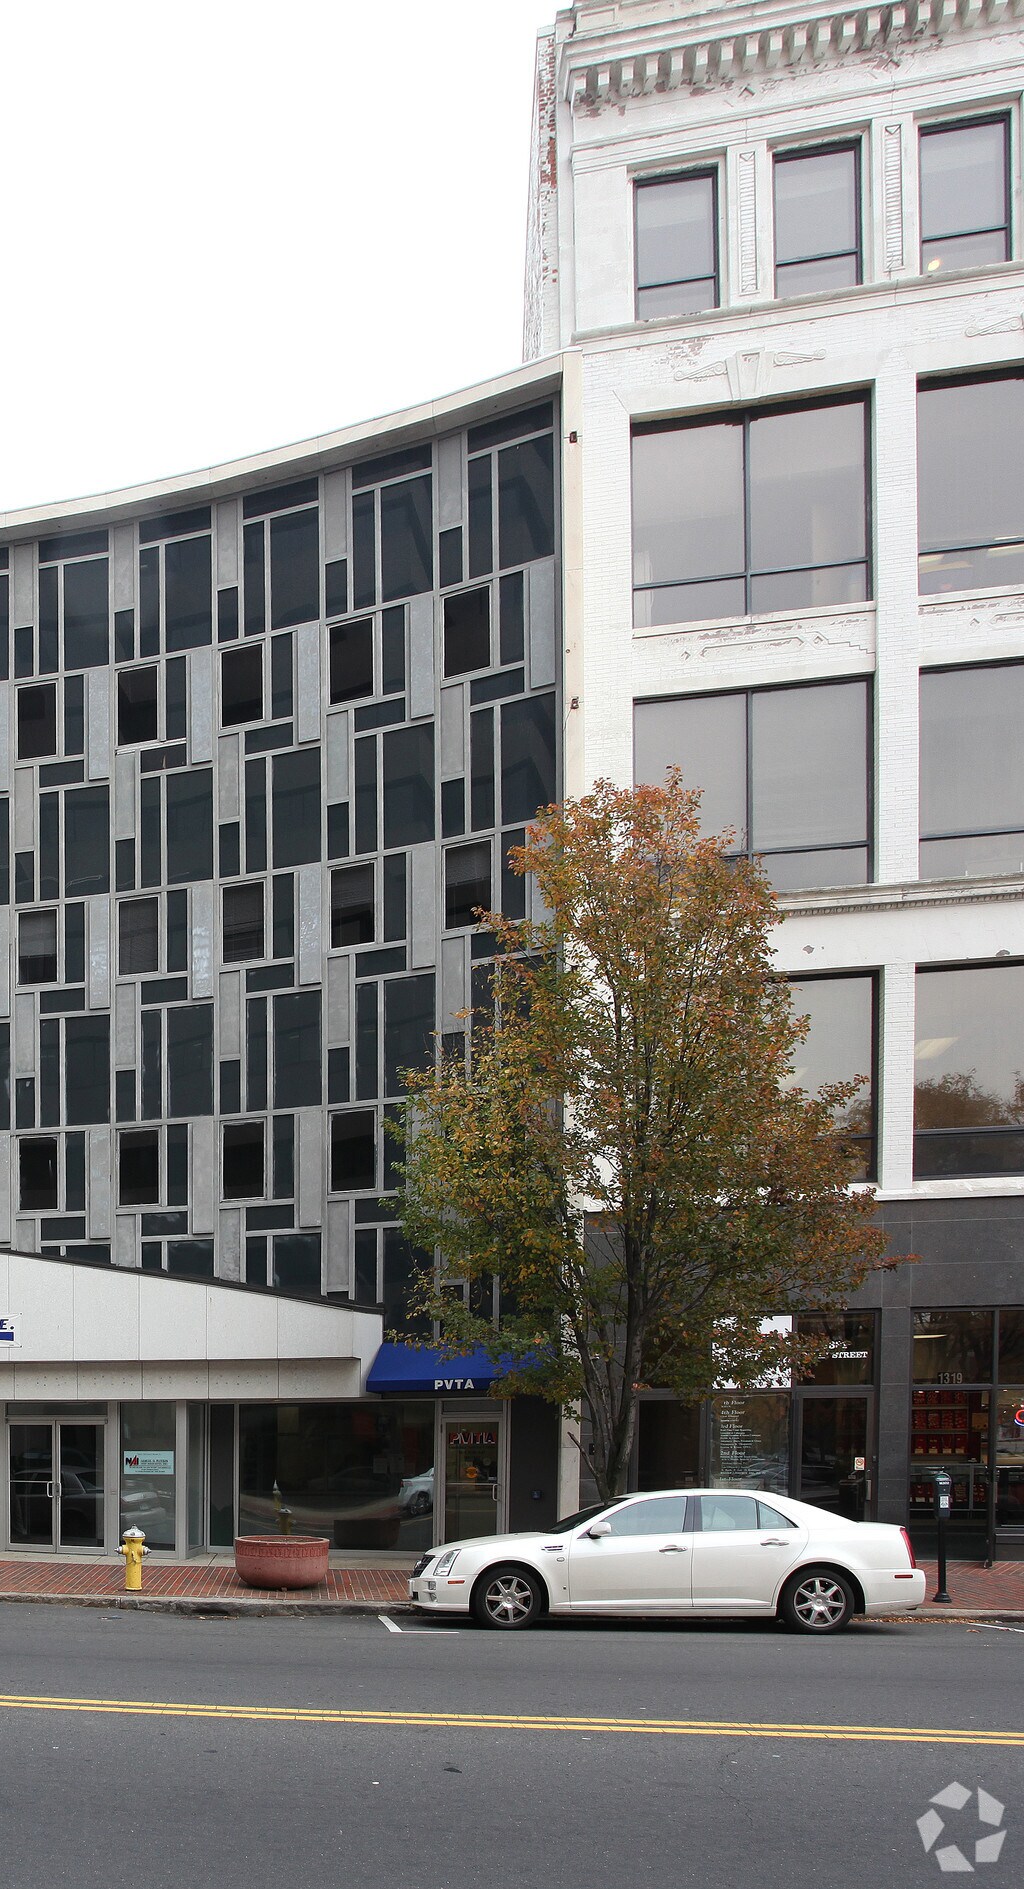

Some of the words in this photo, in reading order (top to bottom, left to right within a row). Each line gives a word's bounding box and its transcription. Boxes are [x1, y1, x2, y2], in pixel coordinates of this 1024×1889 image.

[831, 1351, 869, 1359] STREET
[434, 1378, 475, 1390] PVTA
[938, 1372, 963, 1384] 1319
[449, 1432, 497, 1445] PVTA
[125, 1455, 140, 1467] NAI
